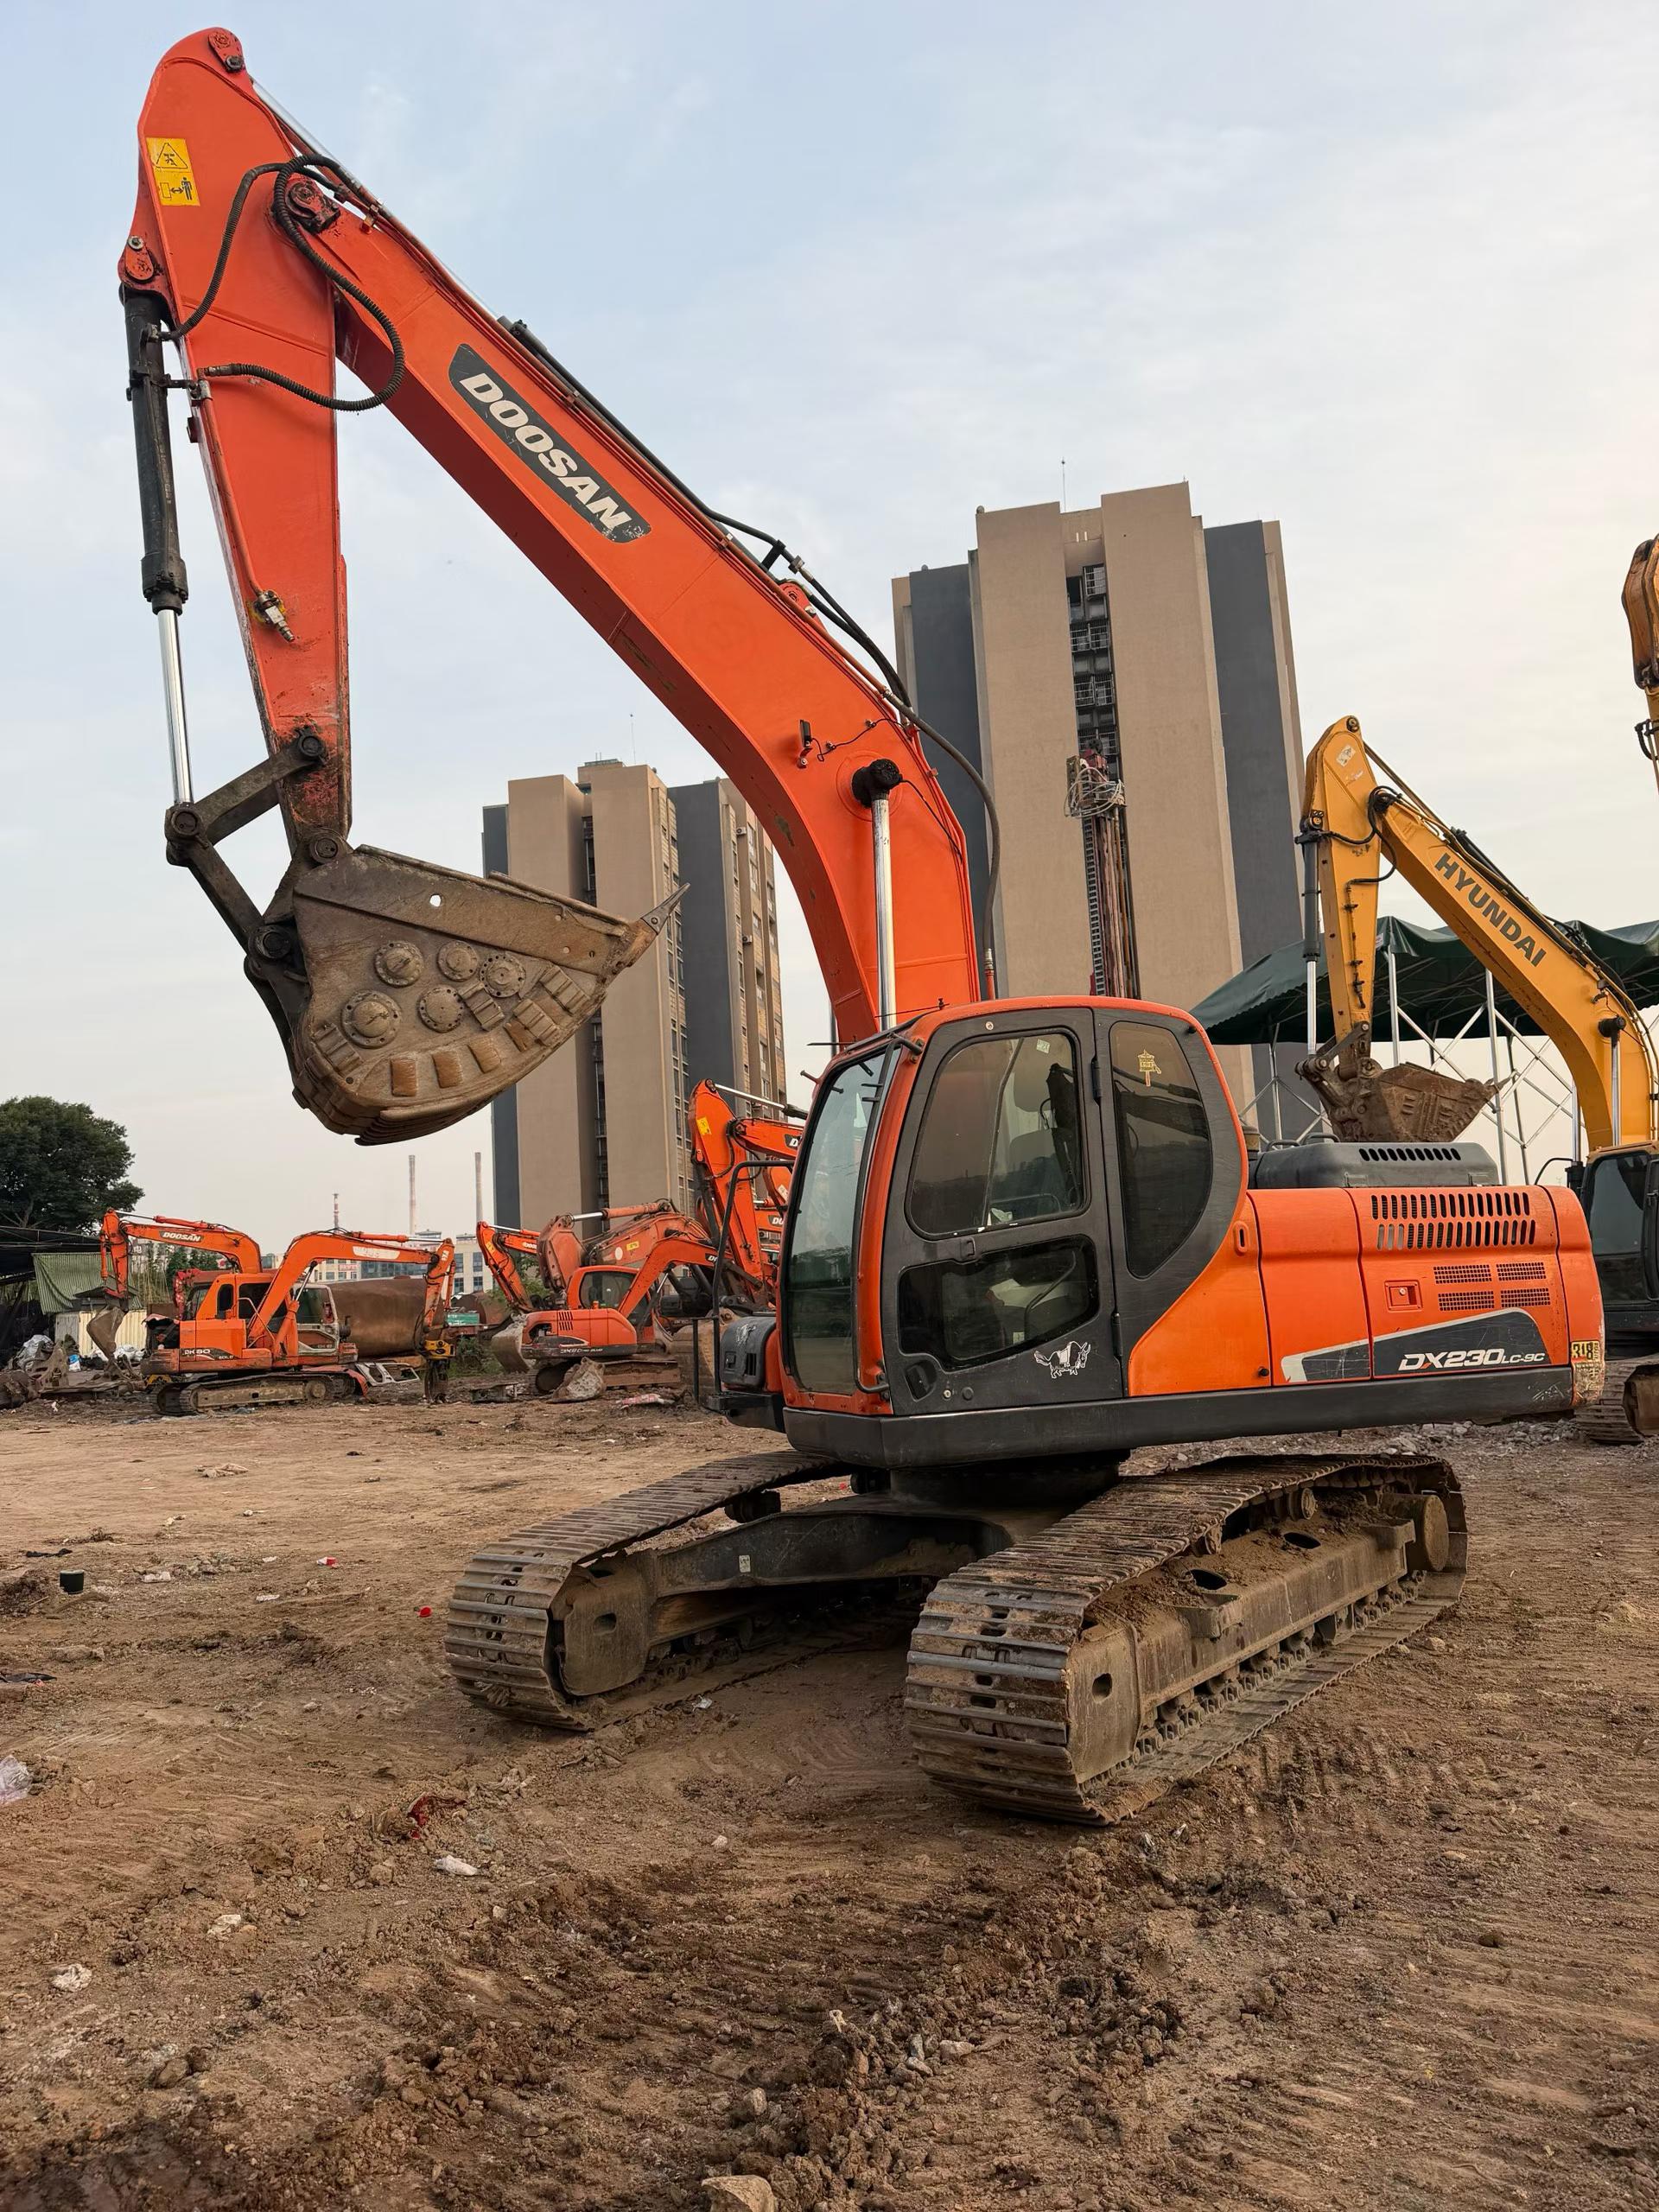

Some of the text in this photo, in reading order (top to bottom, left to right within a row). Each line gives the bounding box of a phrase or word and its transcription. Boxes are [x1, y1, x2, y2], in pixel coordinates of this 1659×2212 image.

[459, 372, 632, 531] DOOSAN
[1434, 853, 1547, 967] HYUNDAI
[162, 1231, 201, 1242] DOOSAN
[1573, 1342, 1593, 1360] 318
